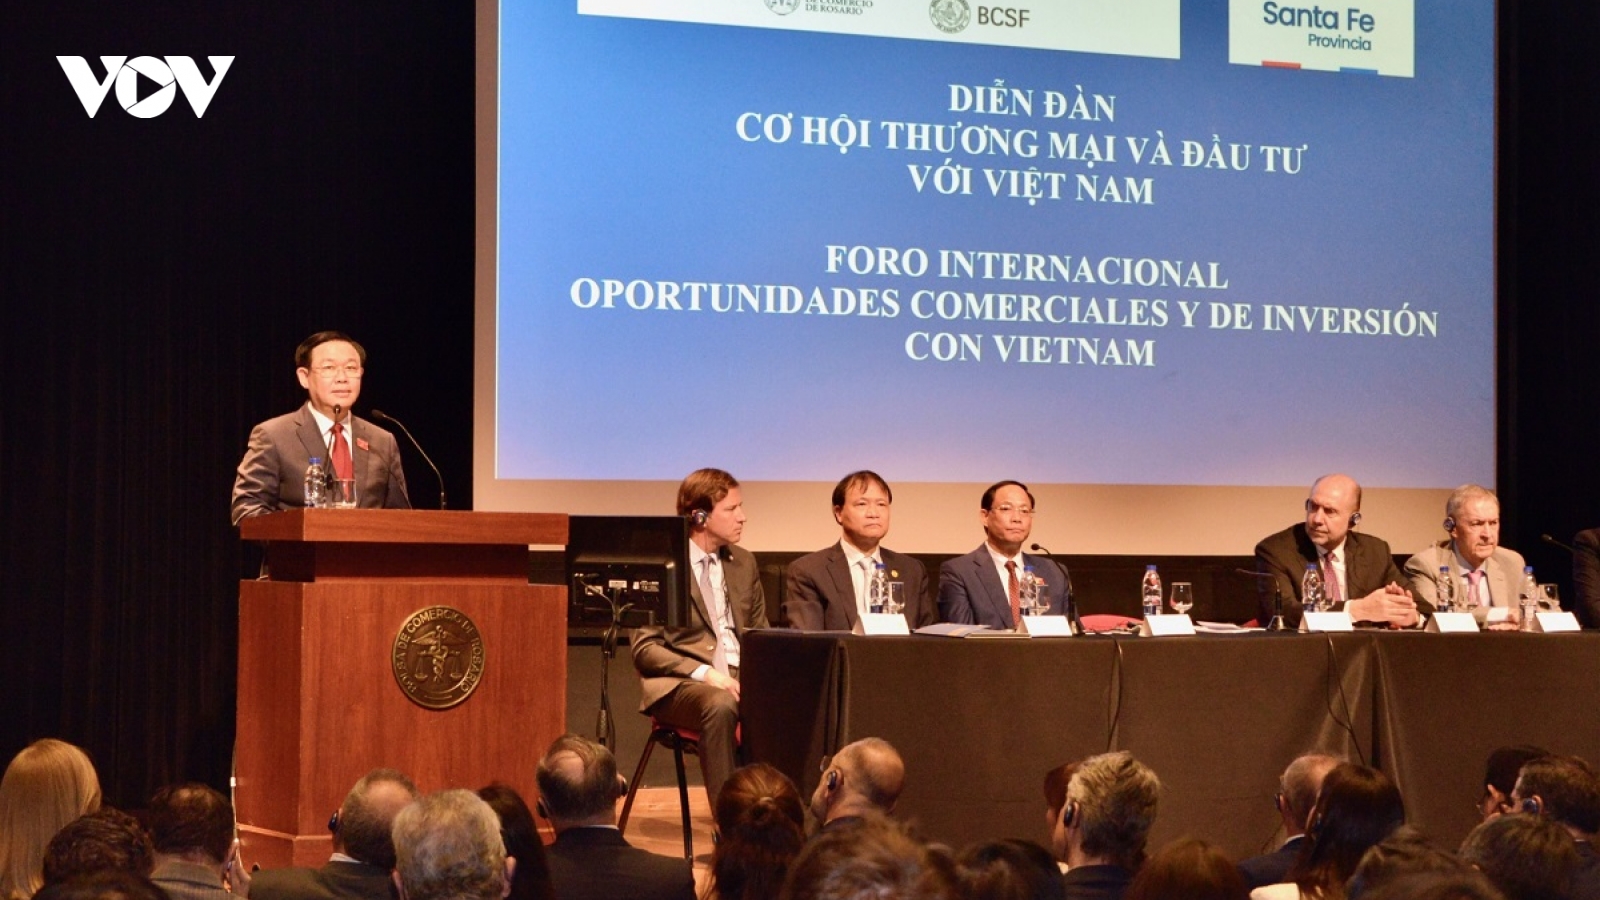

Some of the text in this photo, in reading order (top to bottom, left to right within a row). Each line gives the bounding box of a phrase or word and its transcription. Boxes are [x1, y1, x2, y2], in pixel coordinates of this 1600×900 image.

[805, 3, 864, 15] DE ROSARIO
[978, 6, 1030, 28] BCSF
[1263, 1, 1375, 33] Santa Fe
[1308, 33, 1372, 51] Provincia
[949, 79, 1116, 122] DIỄN ĐÀN
[736, 111, 1308, 174] CƠ HỘI THƯƠNG MẠI VÀ ĐẦU TƯ
[907, 158, 1154, 206] VỚI VIỆT NAM
[826, 245, 1229, 289] FORO INTERNACIONAL
[570, 277, 1438, 338] OPORTUNIDADES COMERCIALES Y DE INVERSIÓN
[905, 331, 1156, 366] CON VIETNAM
[398, 632, 411, 649] DE
[406, 608, 461, 634] COMERCIO
